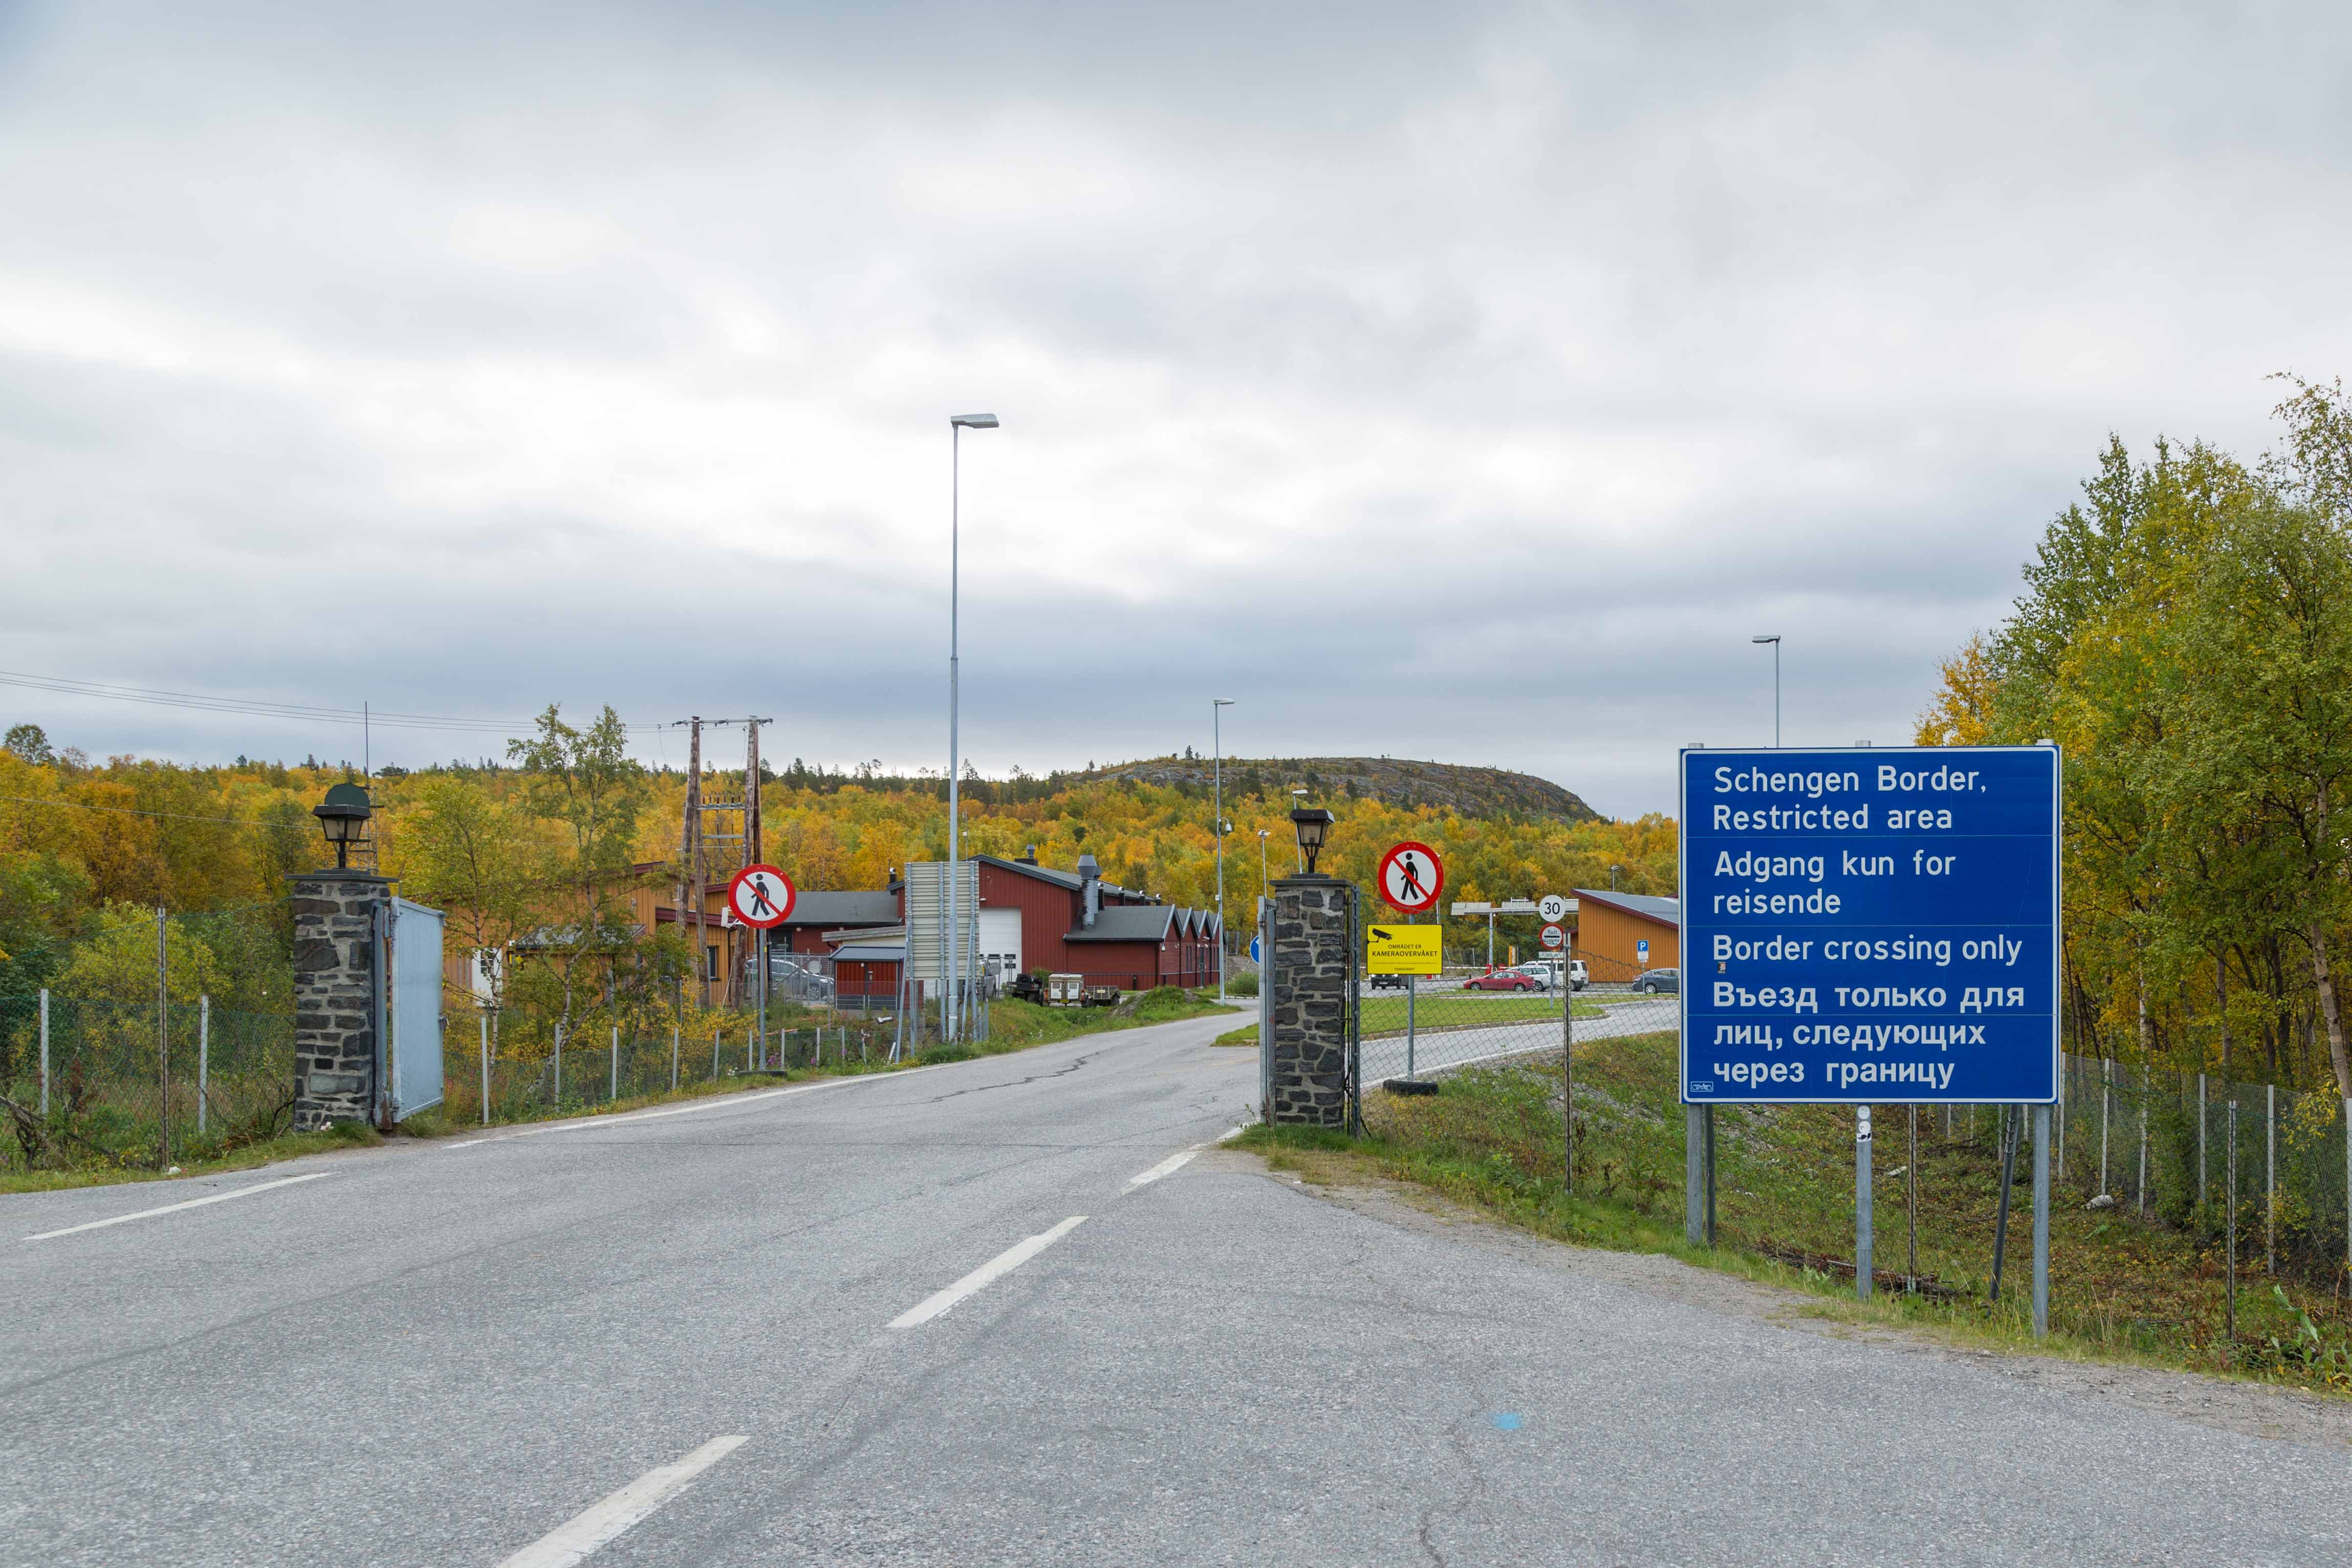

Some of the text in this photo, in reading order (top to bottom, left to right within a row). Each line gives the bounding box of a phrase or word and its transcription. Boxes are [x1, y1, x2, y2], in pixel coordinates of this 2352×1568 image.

[1714, 765, 1986, 798] Schengen Border,
[1714, 803, 1952, 830] Restricted area
[1714, 849, 1956, 883] Adgang kun for
[1544, 902, 1560, 914] 30
[1714, 888, 1841, 914] reisende
[1640, 942, 1646, 951] P
[1714, 934, 2022, 966] Border crossing only
[1714, 981, 2024, 1013] Въезд только для
[1714, 1024, 1986, 1051] лиц, следующих
[1714, 1062, 1955, 1089] через границу
